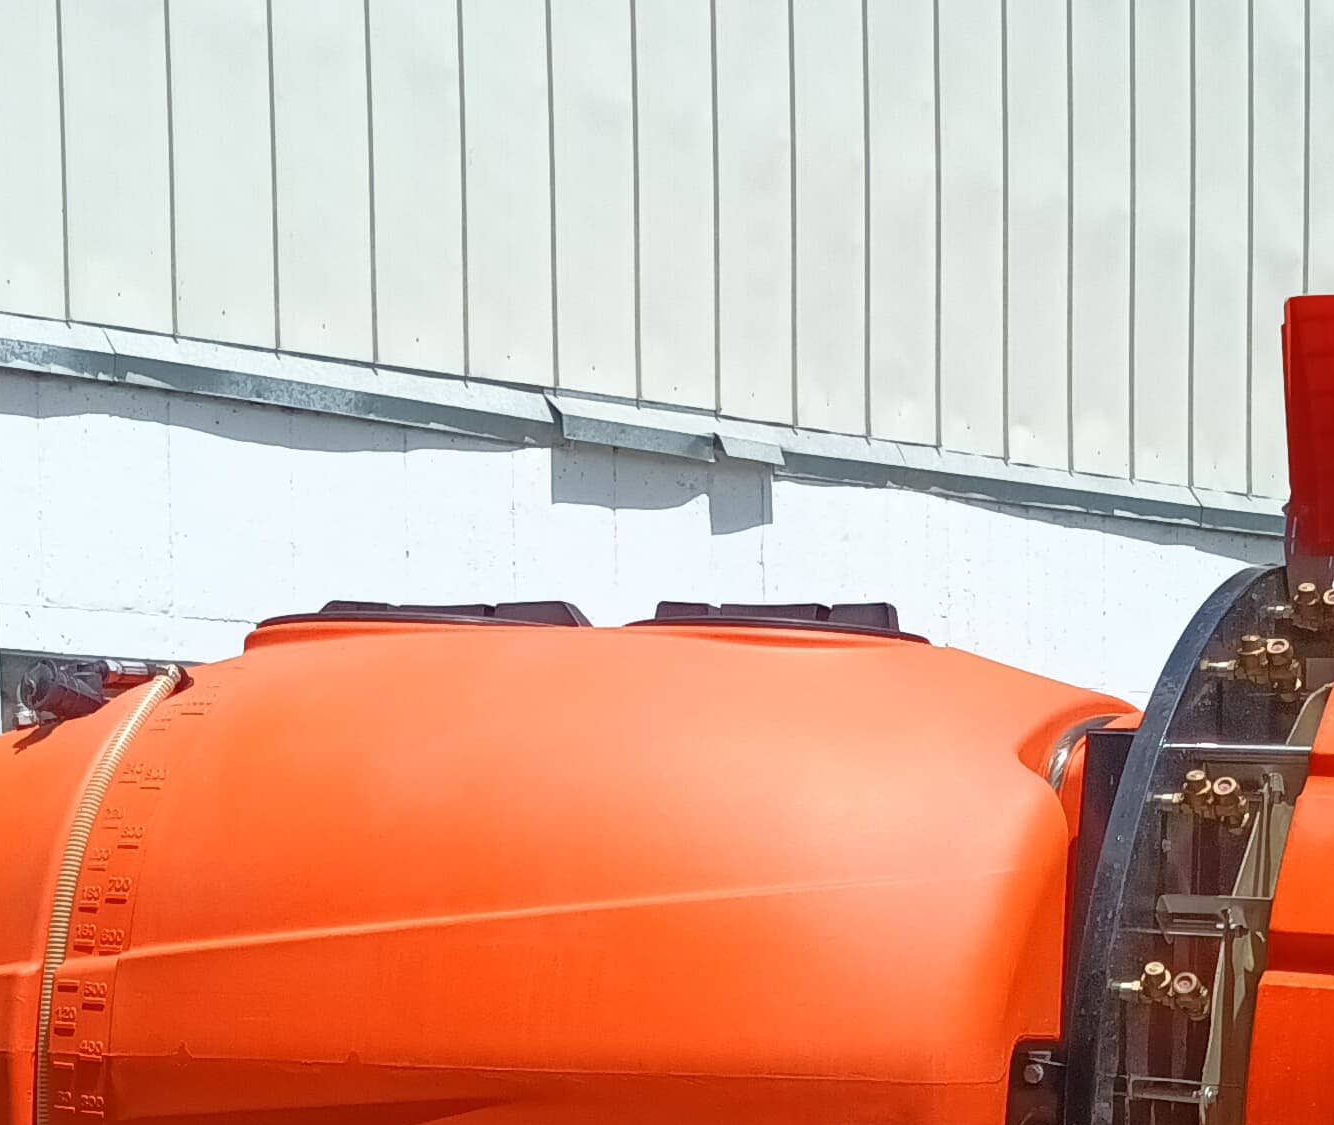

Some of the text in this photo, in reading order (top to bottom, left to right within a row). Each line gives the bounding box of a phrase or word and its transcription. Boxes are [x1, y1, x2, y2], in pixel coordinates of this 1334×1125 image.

[107, 876, 132, 893] 700
[99, 928, 125, 945] 600
[83, 981, 108, 996] 500
[55, 1006, 77, 1020] 120
[79, 1039, 104, 1054] 400
[80, 1094, 105, 1108] 300
